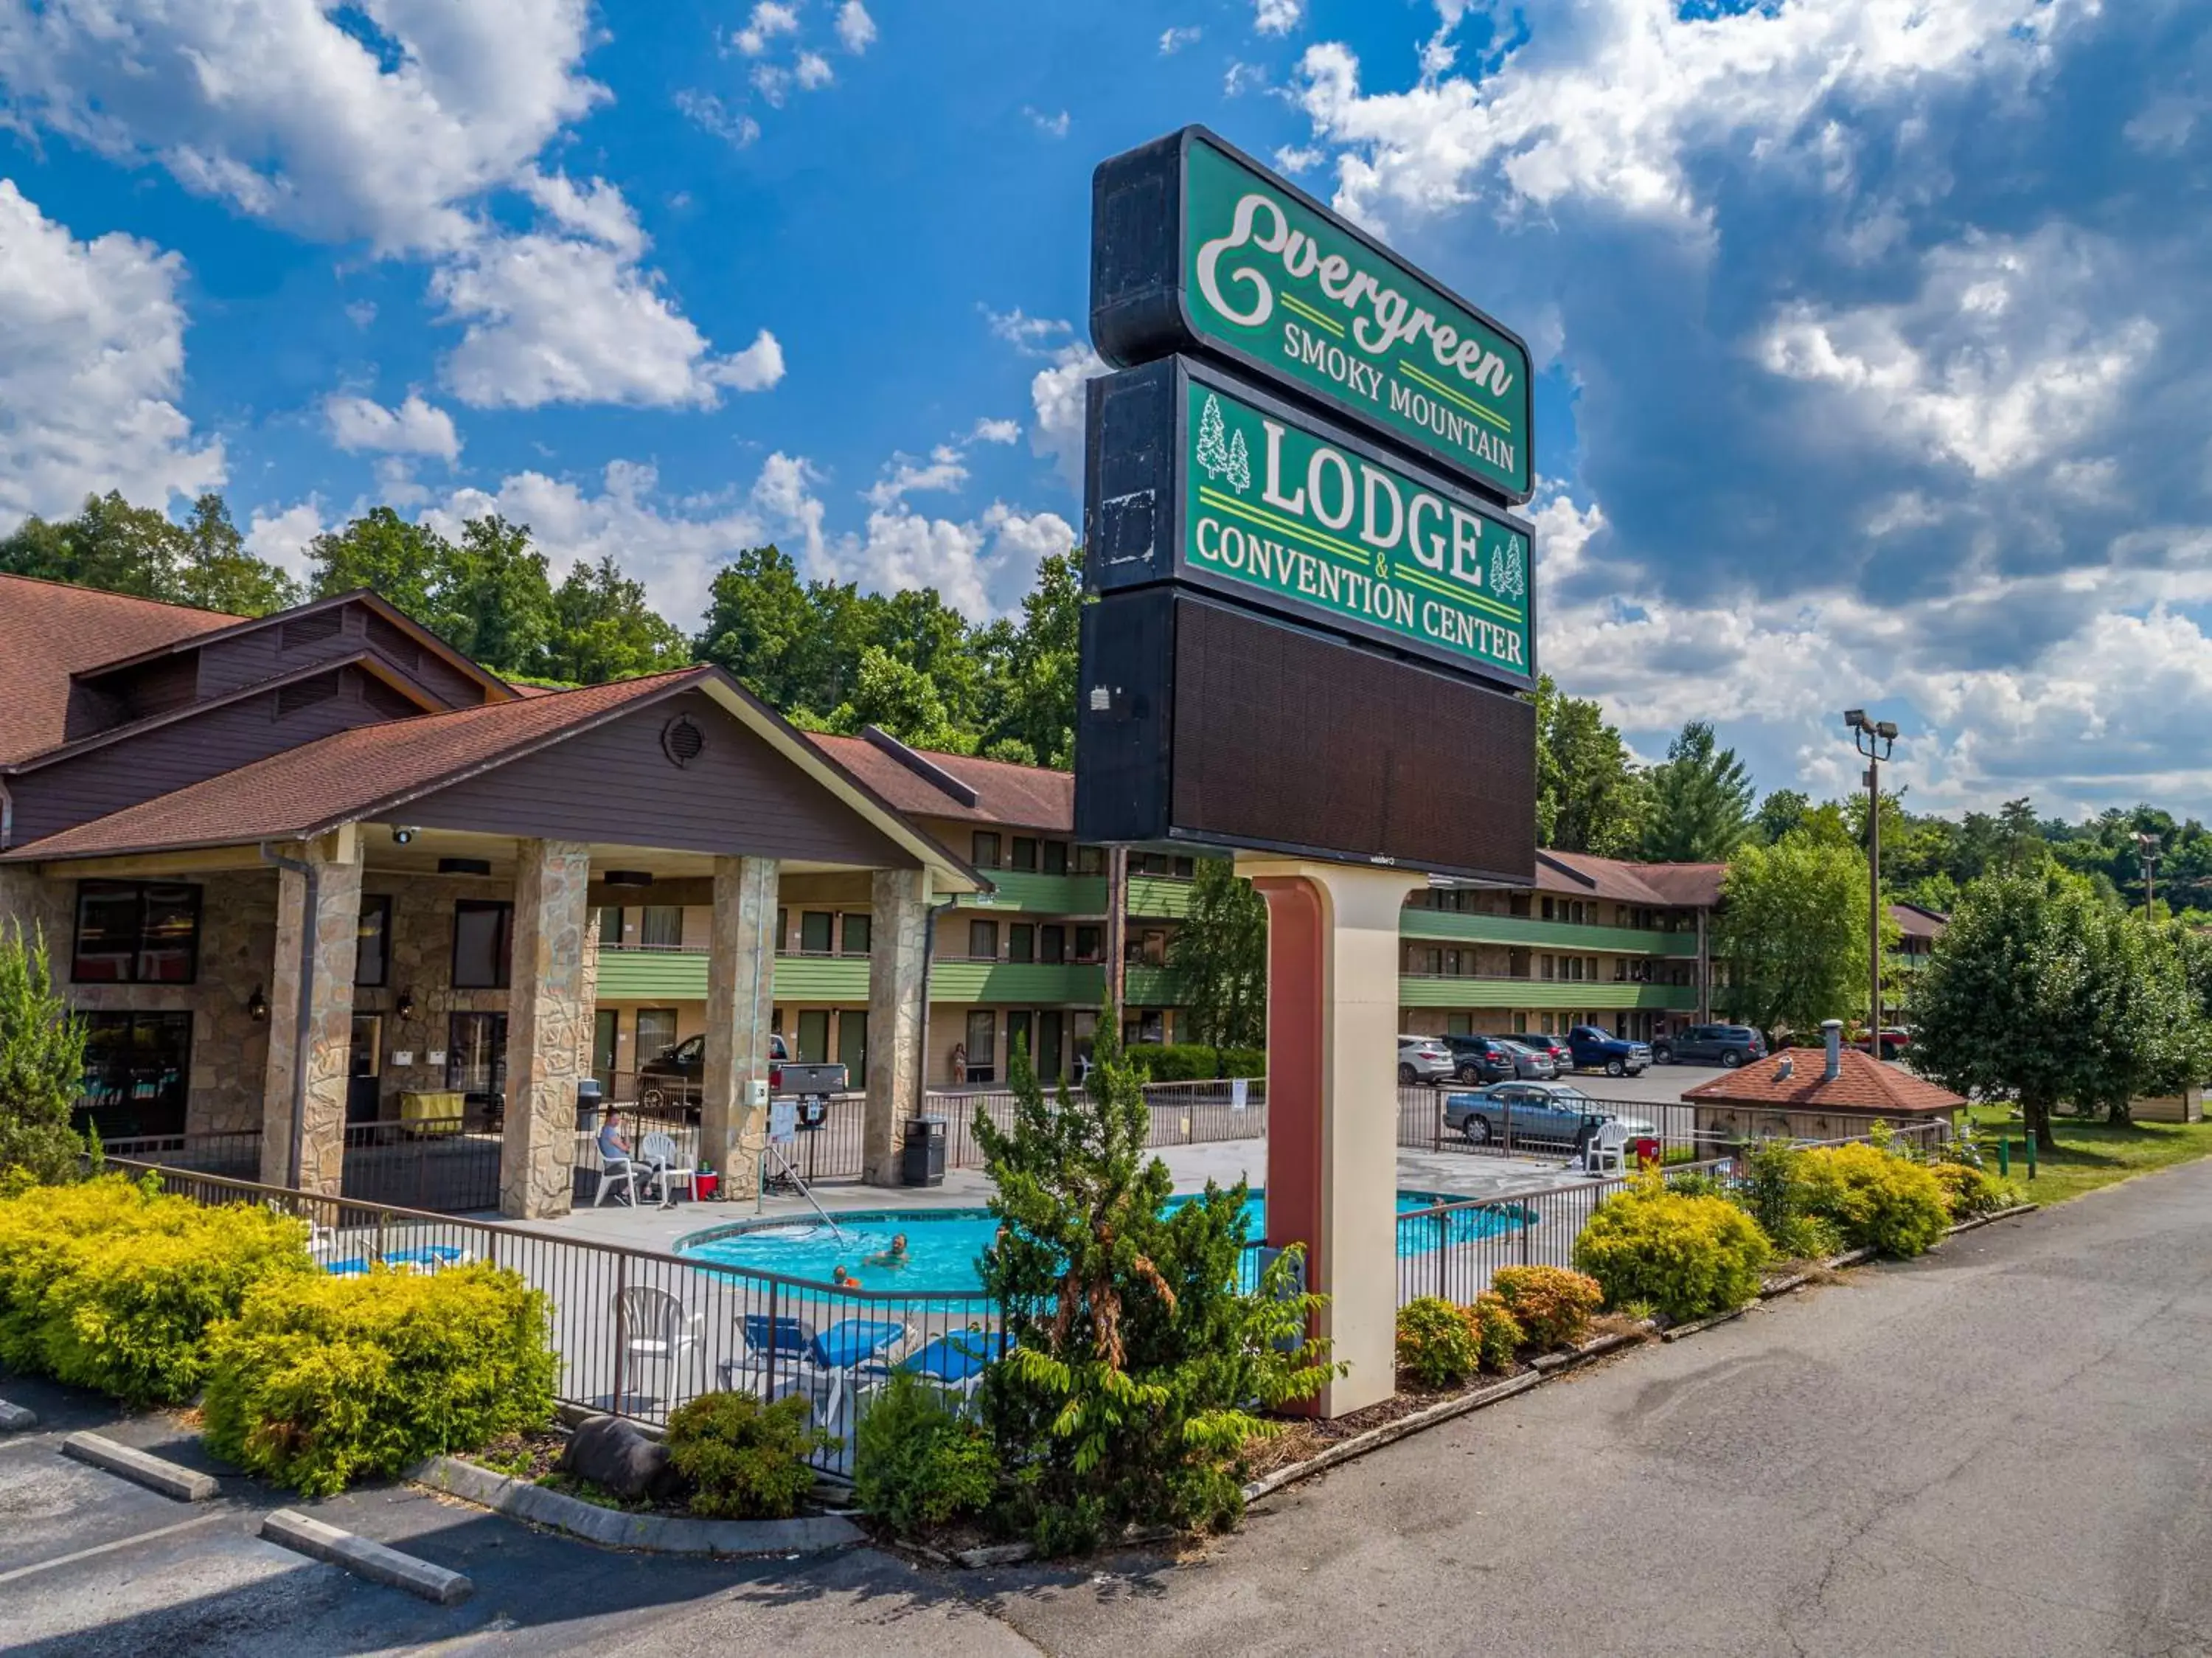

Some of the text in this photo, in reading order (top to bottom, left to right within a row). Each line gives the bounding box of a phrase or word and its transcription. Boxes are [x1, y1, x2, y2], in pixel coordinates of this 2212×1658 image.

[1197, 194, 1512, 397] Evergreen
[1284, 323, 1514, 474] SMOKY MOUNTAIN
[1262, 420, 1482, 586] LODGE
[1375, 552, 1388, 580] &
[1196, 518, 1523, 665] CONVENTION CENTER
